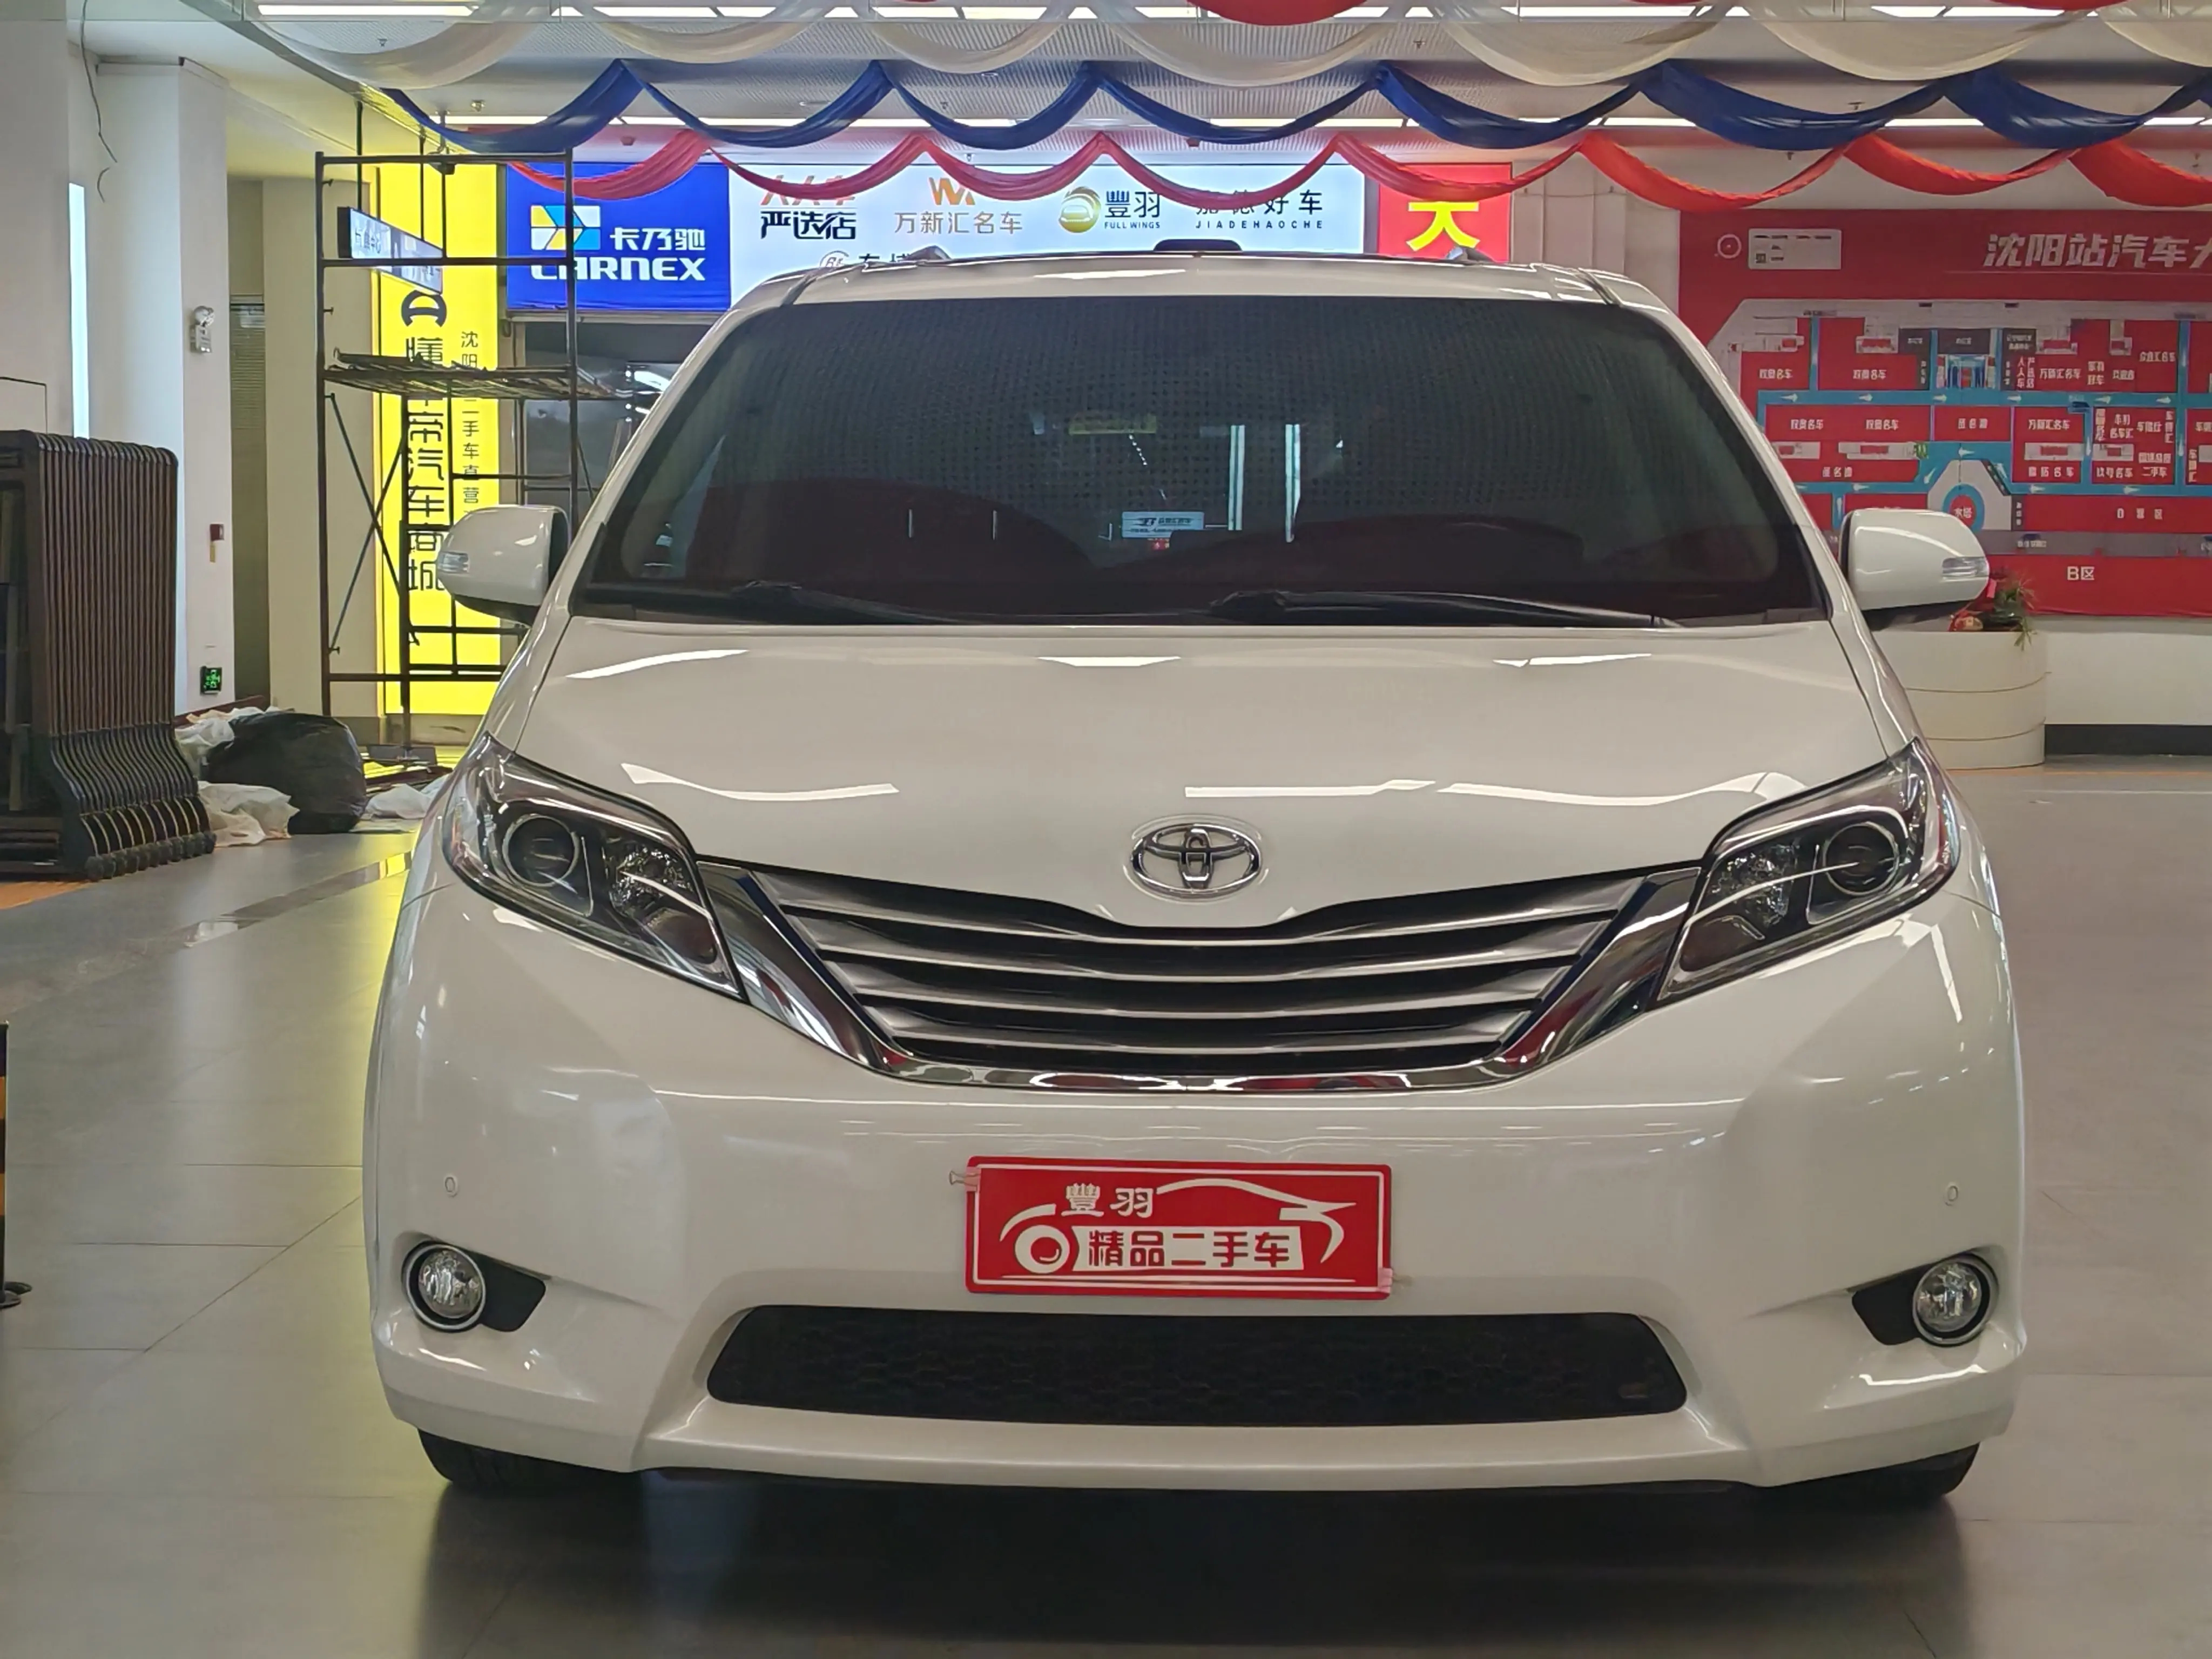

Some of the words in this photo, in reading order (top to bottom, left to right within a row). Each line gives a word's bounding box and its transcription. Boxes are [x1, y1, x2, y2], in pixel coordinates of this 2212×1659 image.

[1195, 189, 1323, 215] 好车
[760, 211, 857, 240] 严选店
[894, 211, 1022, 234] 万新汇名车
[1104, 221, 1127, 230] FULL
[1130, 221, 1161, 230] WINGS
[610, 227, 706, 251] 卡乃驰
[2067, 566, 2095, 581] B区
[1089, 1230, 1290, 1268] 精品二手车
